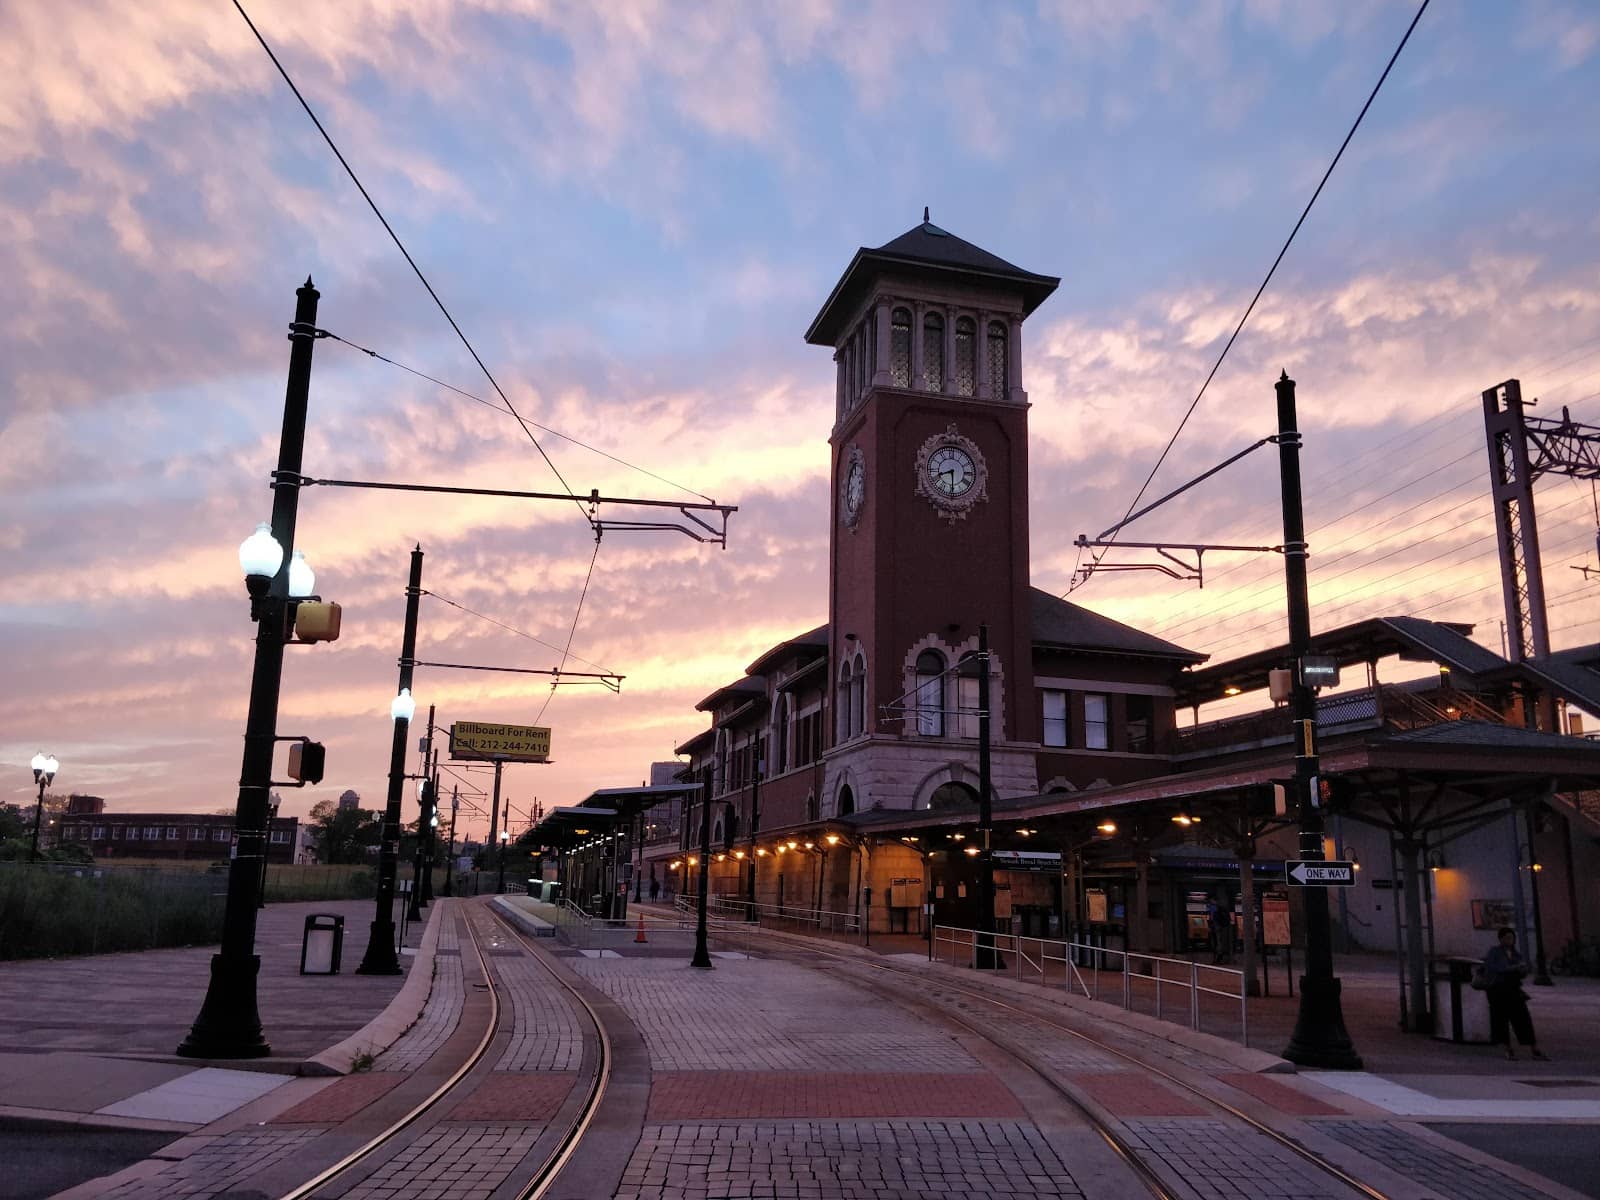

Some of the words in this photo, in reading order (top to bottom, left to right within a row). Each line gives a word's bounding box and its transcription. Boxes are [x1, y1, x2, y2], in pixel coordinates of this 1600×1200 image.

[459, 724, 505, 736] Billboard
[507, 727, 524, 737] For
[525, 729, 547, 739] Rent
[456, 738, 478, 748] Call:
[480, 740, 548, 753] 212-244-7410
[1306, 868, 1325, 878] ONE
[1328, 869, 1347, 879] WAY
